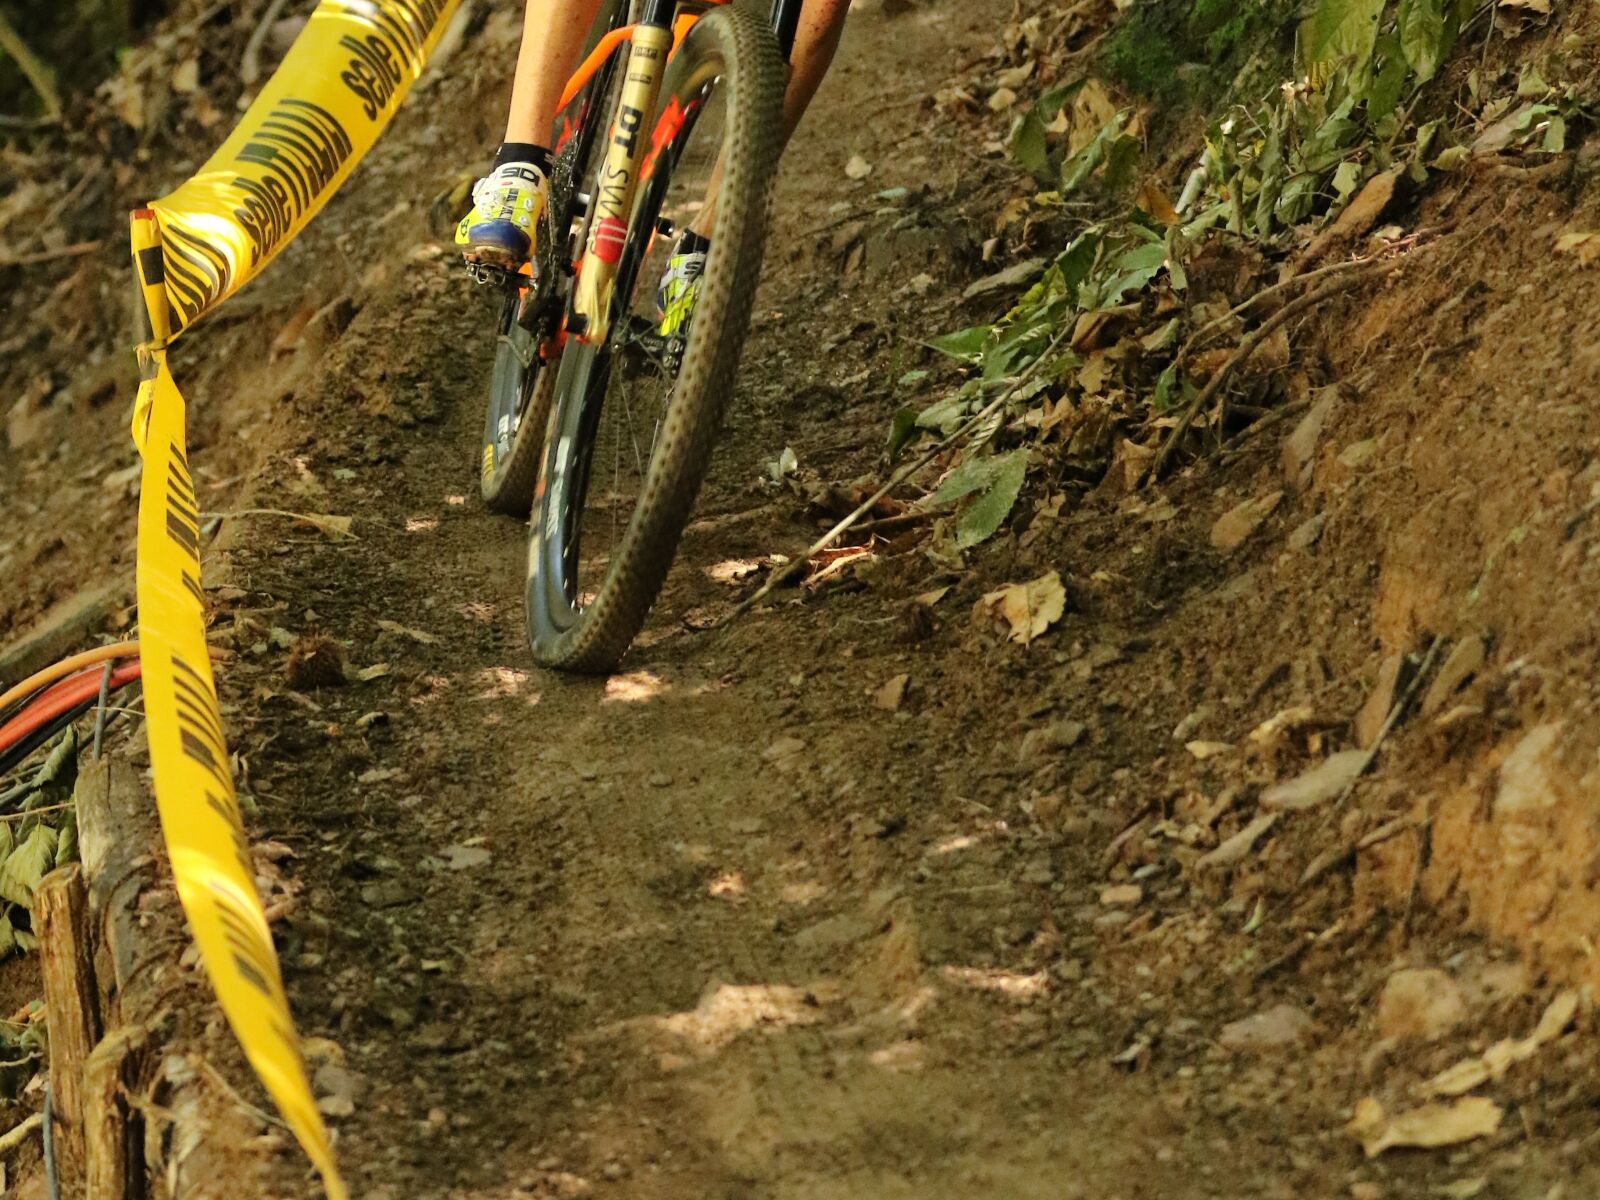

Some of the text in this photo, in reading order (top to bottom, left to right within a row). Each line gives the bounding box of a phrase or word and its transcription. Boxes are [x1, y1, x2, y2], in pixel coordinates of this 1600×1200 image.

[339, 34, 401, 121] selle
[615, 104, 643, 160] DT
[232, 99, 352, 268] selle ITALIA
